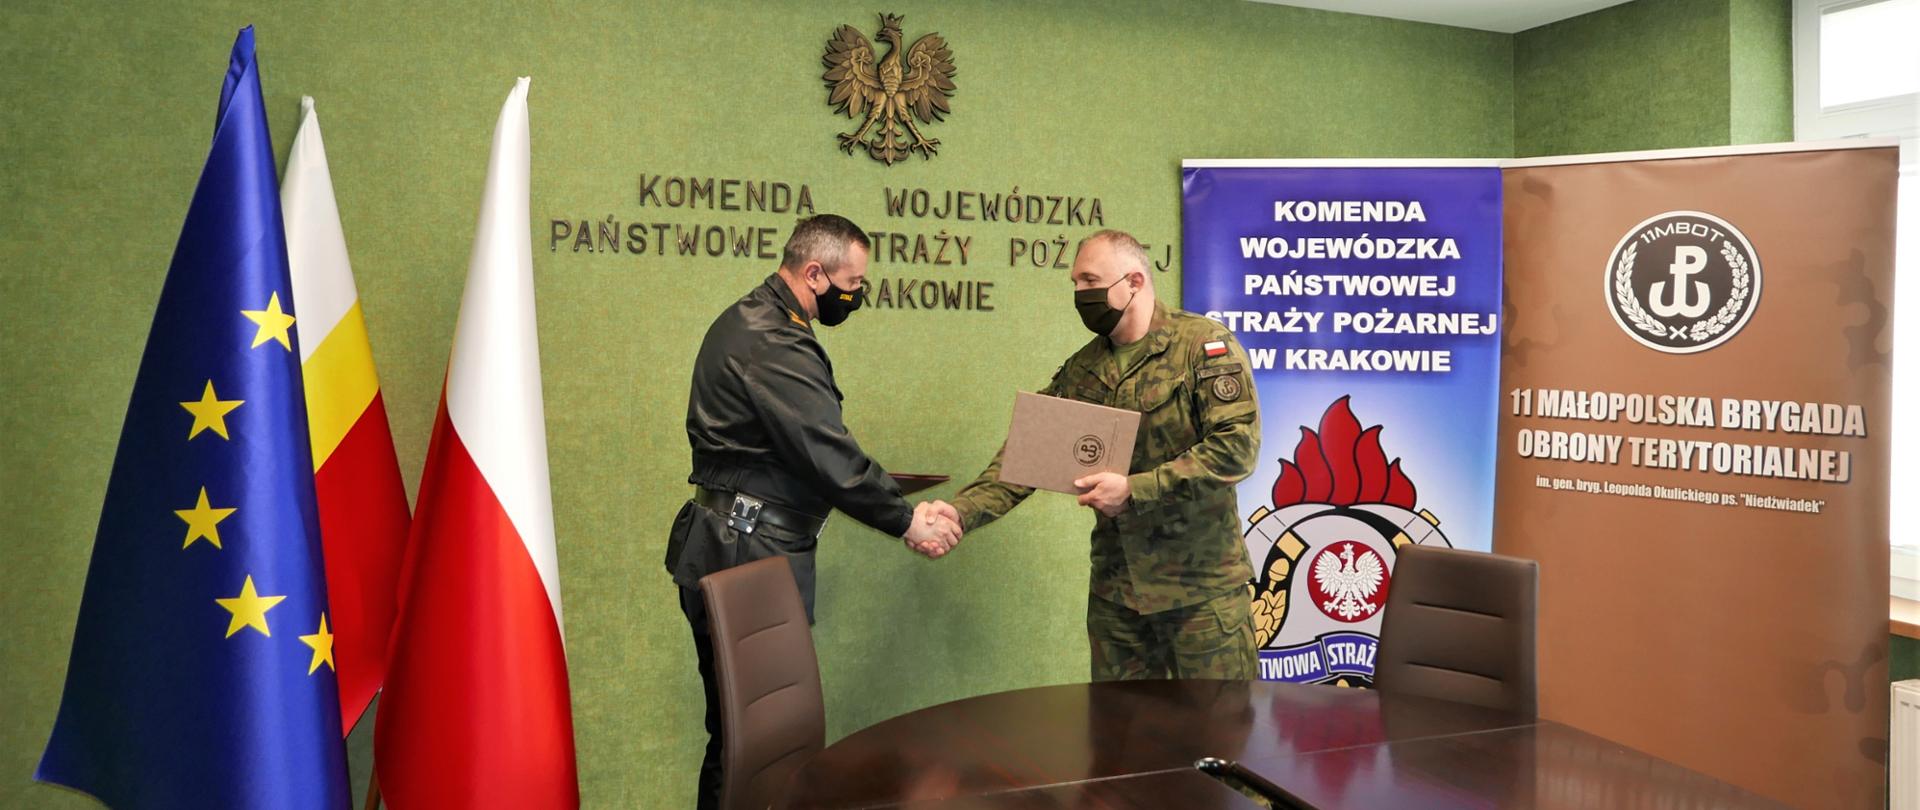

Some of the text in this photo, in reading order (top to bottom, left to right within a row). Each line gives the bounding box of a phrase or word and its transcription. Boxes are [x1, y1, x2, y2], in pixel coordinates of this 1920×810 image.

[639, 173, 1104, 227] KOMENDA WOJEWÓDZKA
[1274, 201, 1426, 222] KOMENDA
[551, 214, 778, 259] PAŃSTWOWE
[868, 229, 972, 266] TRAŻY
[1240, 233, 1460, 259] WOJEWÓDZKA
[1640, 222, 1725, 244] 11MBOT
[860, 278, 994, 311] RAKOWIE
[1244, 269, 1456, 297] PAŃSTWOWEJ
[1333, 307, 1498, 335] POŻARNEJ
[1248, 348, 1451, 372] W KRAKOWIE
[1510, 388, 1867, 437] 11 MAŁOPOLSKA BRYGADA
[1517, 429, 1851, 482] OBRONY TERYTORIALNEJ
[1536, 475, 1552, 488] im.
[1553, 478, 1575, 490] gen.
[1576, 479, 1602, 494] bryg.
[1604, 481, 1652, 497] Leopolda
[1653, 485, 1719, 504] Okulickiego
[1721, 493, 1739, 506] ps.
[1260, 643, 1377, 680] TWOWA STRAŻ
